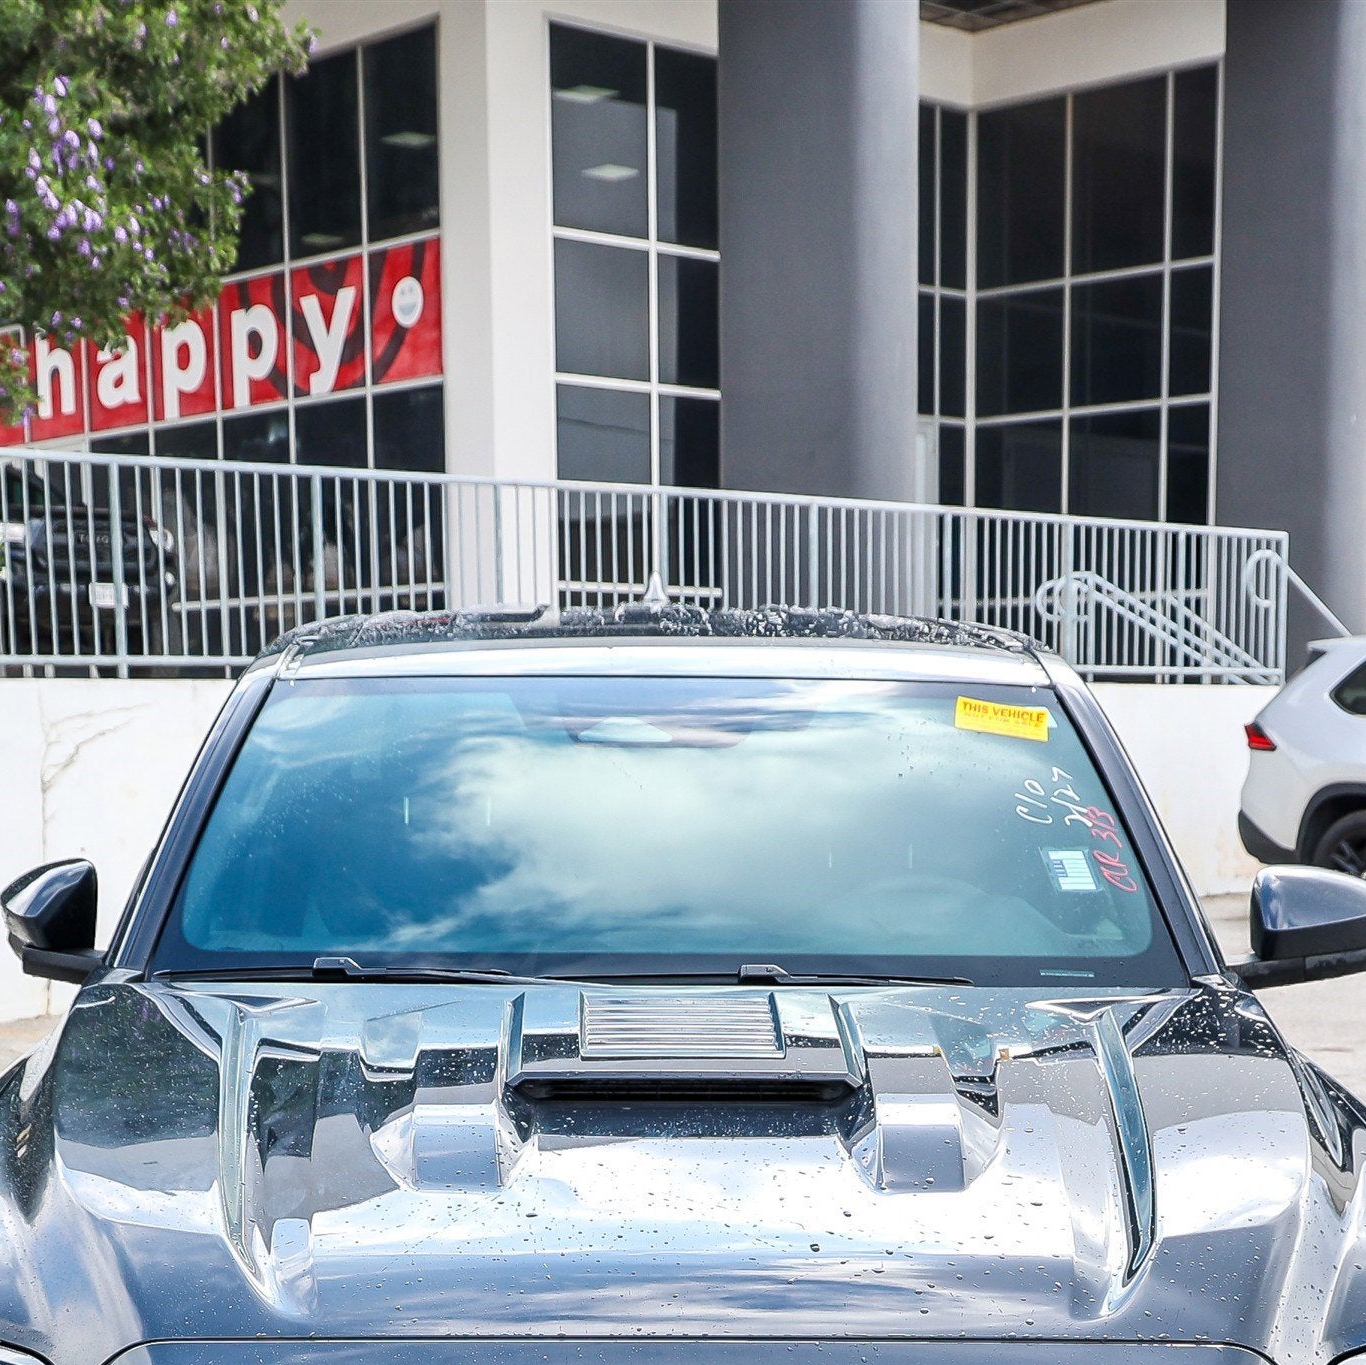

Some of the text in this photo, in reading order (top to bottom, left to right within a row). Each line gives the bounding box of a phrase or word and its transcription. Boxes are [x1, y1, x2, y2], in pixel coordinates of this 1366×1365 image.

[37, 286, 356, 420] happy
[962, 701, 989, 714] THIS
[992, 706, 1045, 723] VEHICLE
